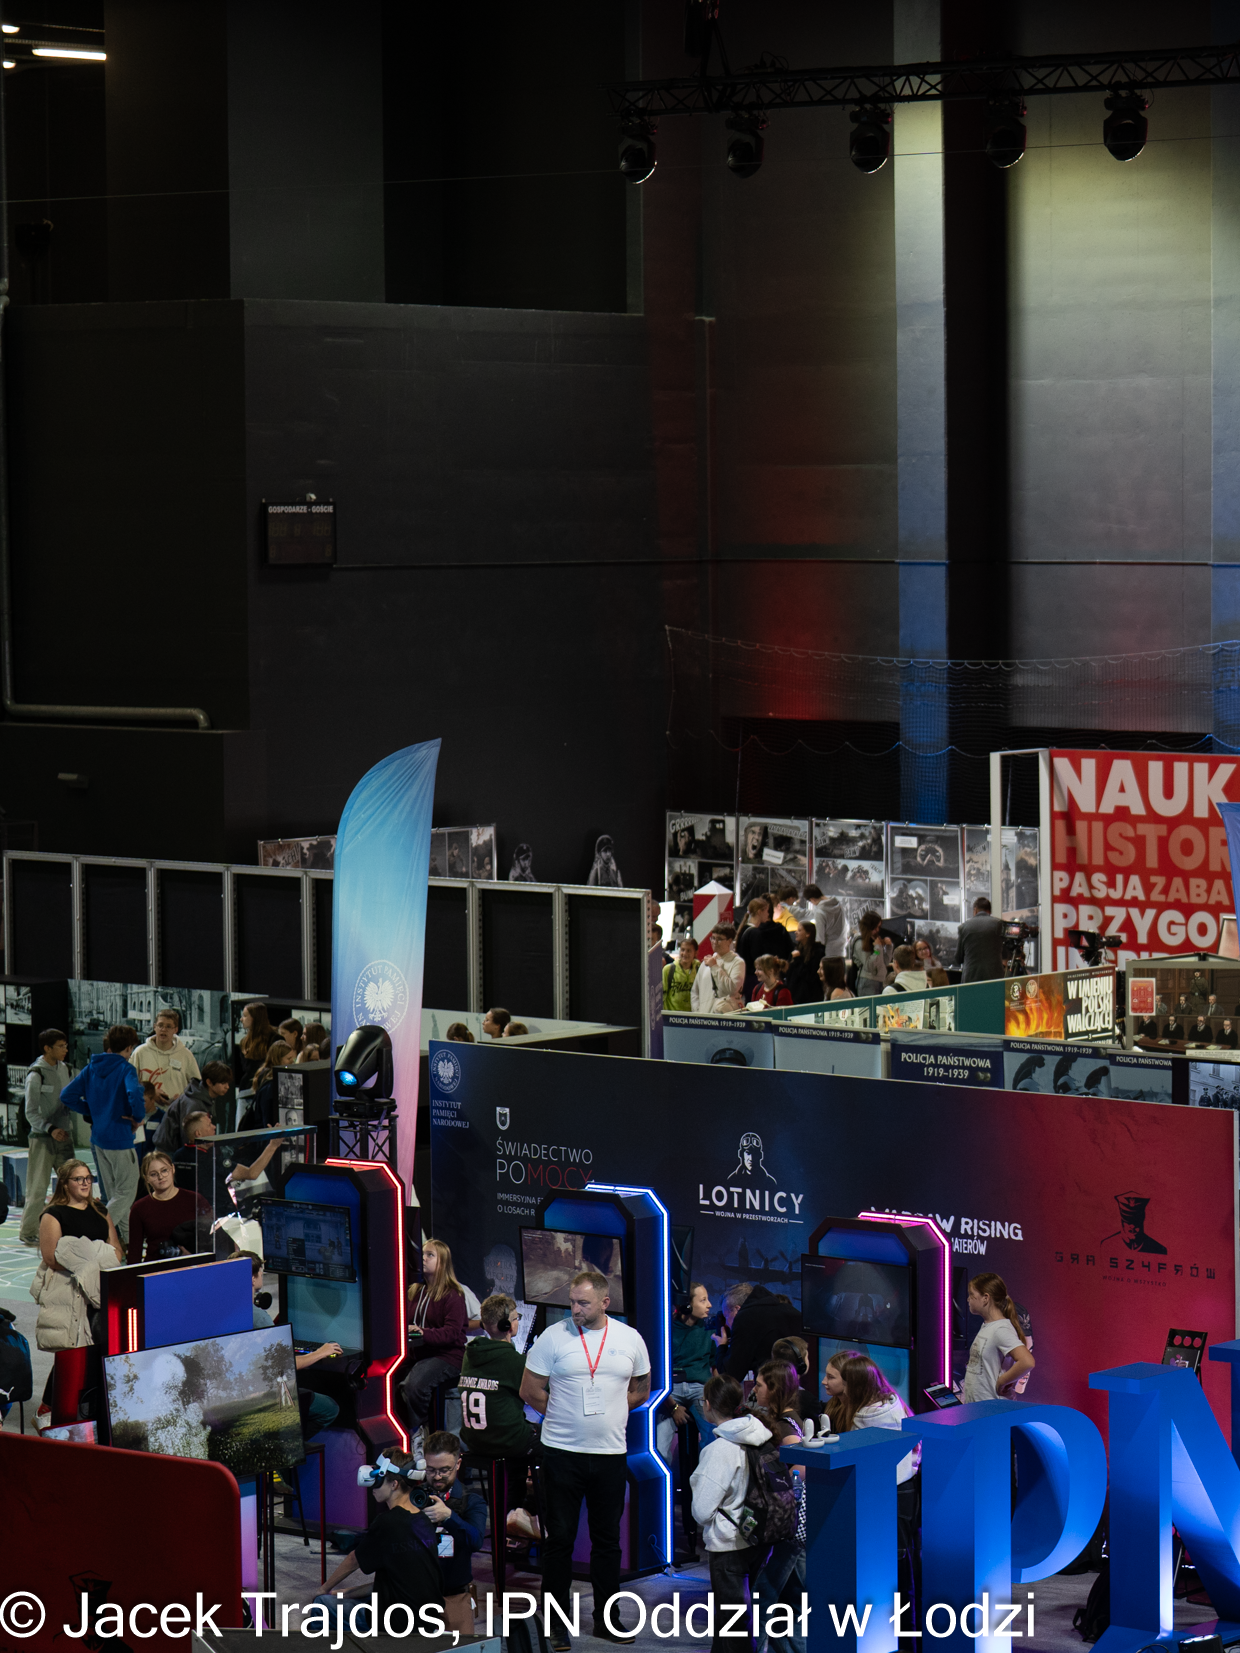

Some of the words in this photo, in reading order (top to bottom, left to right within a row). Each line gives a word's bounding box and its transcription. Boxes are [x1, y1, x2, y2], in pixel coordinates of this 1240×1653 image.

[268, 505, 308, 514] GOSPODARZE
[311, 504, 334, 513] GOŚCIE
[1053, 870, 1145, 901] PASJA
[1149, 876, 1236, 906] ZABA
[1053, 903, 1236, 949] PRZYGO
[355, 965, 383, 1008] INSTYTUT
[383, 965, 405, 1005] PAMIĘCI
[1067, 981, 1078, 1000] W
[1078, 975, 1113, 999] IMIENIU
[1081, 992, 1113, 1014] POLSKI
[669, 1017, 688, 1026] POLICJA
[689, 1018, 719, 1026] PAŃSTWOWA
[1067, 1010, 1113, 1033] WALCZĄCEJ
[778, 1026, 797, 1035] POLICJA
[798, 1027, 828, 1037] PAŃSTWOWA
[1010, 1042, 1031, 1051] POLICJA
[1032, 1043, 1064, 1052] PAŃSTWOWA
[901, 1053, 936, 1066] POLICJA
[937, 1055, 991, 1068] PAŃSTWOWA
[1115, 1056, 1137, 1065] POLICJA
[1138, 1057, 1172, 1067] PAŃSTWOWA
[923, 1066, 969, 1079] 1919–1939
[432, 1099, 462, 1109] INSTYTUT
[432, 1108, 457, 1119] PAMIĘCI
[432, 1118, 470, 1129] NARODOWEJ
[496, 1136, 593, 1164] ŚWIADECTWO
[496, 1159, 593, 1190] POMOCY
[497, 1192, 536, 1204] IMMERSYJNA
[699, 1183, 804, 1214] LOTNICY
[497, 1204, 503, 1213] O
[504, 1205, 530, 1216] LOSACH
[715, 1210, 735, 1218] WOJNA
[742, 1213, 789, 1224] PRZESTWORZACH
[960, 1216, 1024, 1241] RISING
[1109, 1256, 1216, 1280] SZYFRÓW
[477, 1377, 499, 1391] AWARDS
[461, 1390, 487, 1430] 19
